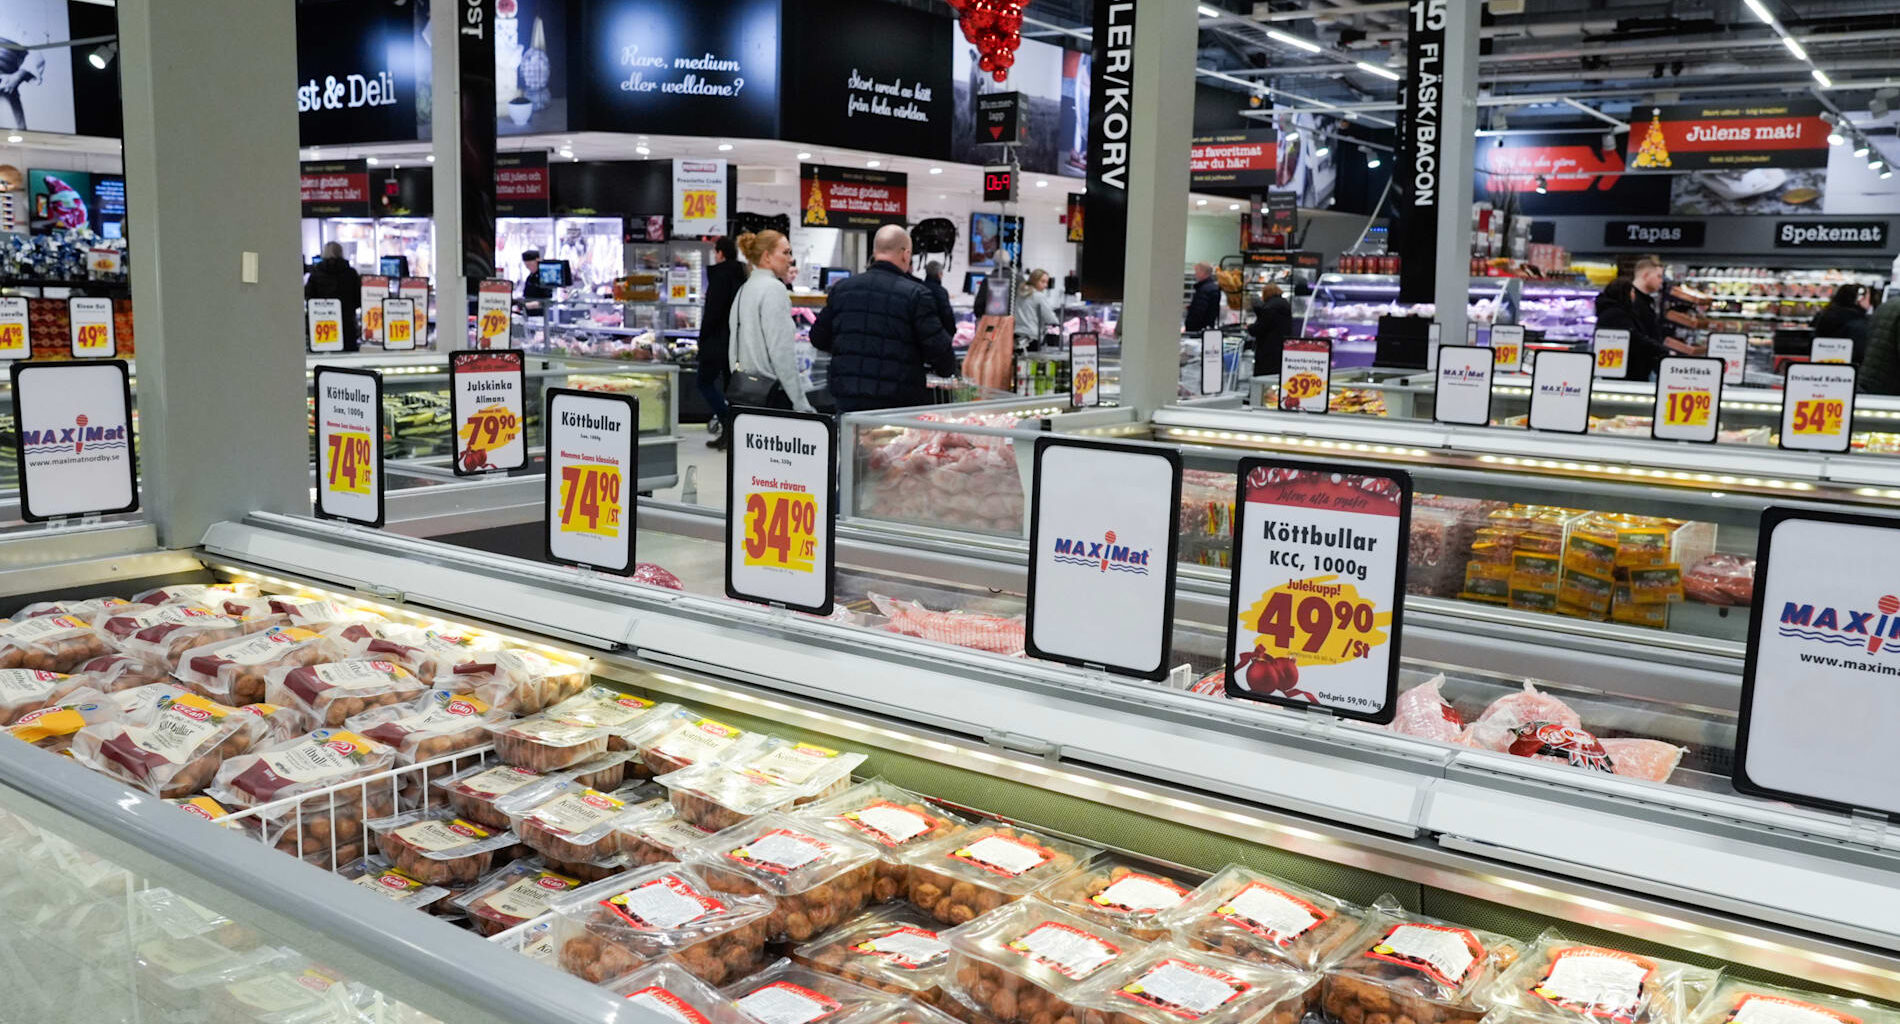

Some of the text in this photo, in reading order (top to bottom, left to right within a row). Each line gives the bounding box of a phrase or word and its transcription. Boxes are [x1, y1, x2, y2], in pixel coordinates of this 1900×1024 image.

[1410, 1, 1447, 32] 15
[620, 45, 740, 72] Rare, medium
[323, 75, 345, 110] &
[347, 71, 397, 107] Deli
[620, 71, 744, 96] eller welldone?
[848, 93, 870, 117] från
[871, 95, 892, 116] hela
[1101, 2, 1134, 190] LER/KORV
[1415, 43, 1442, 206] FLÄSK/BACON
[1685, 122, 1802, 142] Julens mat!
[1205, 146, 1263, 158] favoritmat
[1210, 158, 1225, 169] du
[1226, 157, 1250, 168] här!
[872, 201, 883, 211] du
[1627, 224, 1682, 242] Tapas
[1781, 223, 1882, 244] Spekemat
[327, 386, 370, 404] Köttbullar
[467, 380, 513, 393] Julskinka
[562, 411, 621, 433] Köttbullar
[746, 432, 817, 457] Köttbullar
[752, 475, 806, 494] Svensk råvara
[1264, 520, 1377, 552] Köttbullar
[1270, 550, 1367, 580] KCC, 1000g
[1287, 579, 1341, 598] Julekupp!
[1342, 638, 1370, 659] /St
[1318, 691, 1345, 703] Ord.pris
